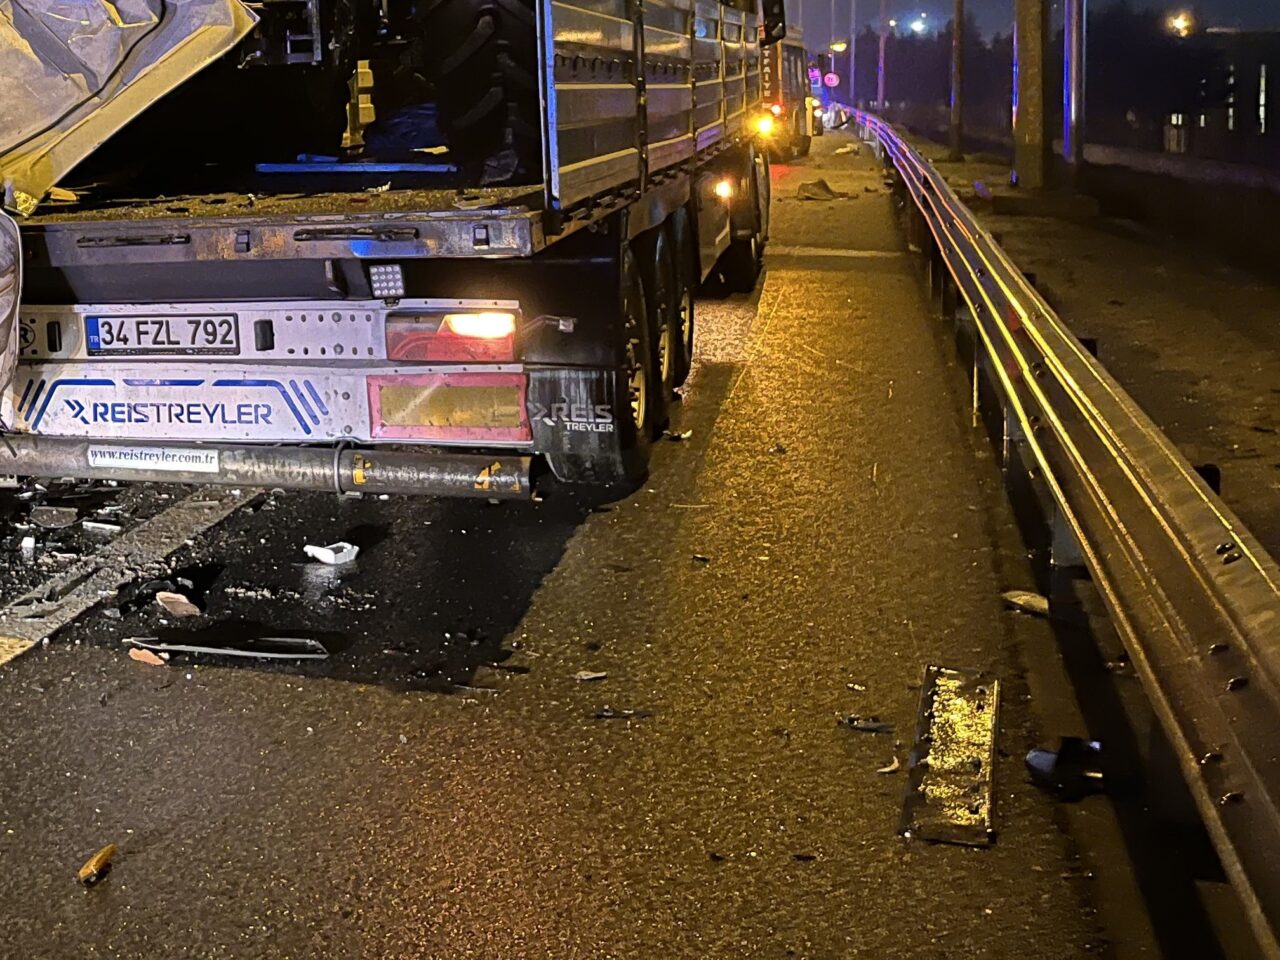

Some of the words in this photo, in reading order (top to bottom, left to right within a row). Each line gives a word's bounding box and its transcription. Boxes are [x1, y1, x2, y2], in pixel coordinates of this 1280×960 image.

[101, 320, 129, 346] 34
[135, 320, 181, 346] FZL
[187, 319, 234, 346] 792
[564, 422, 614, 433] TREYLER
[90, 448, 216, 466] www.reistreyler.com.tr
